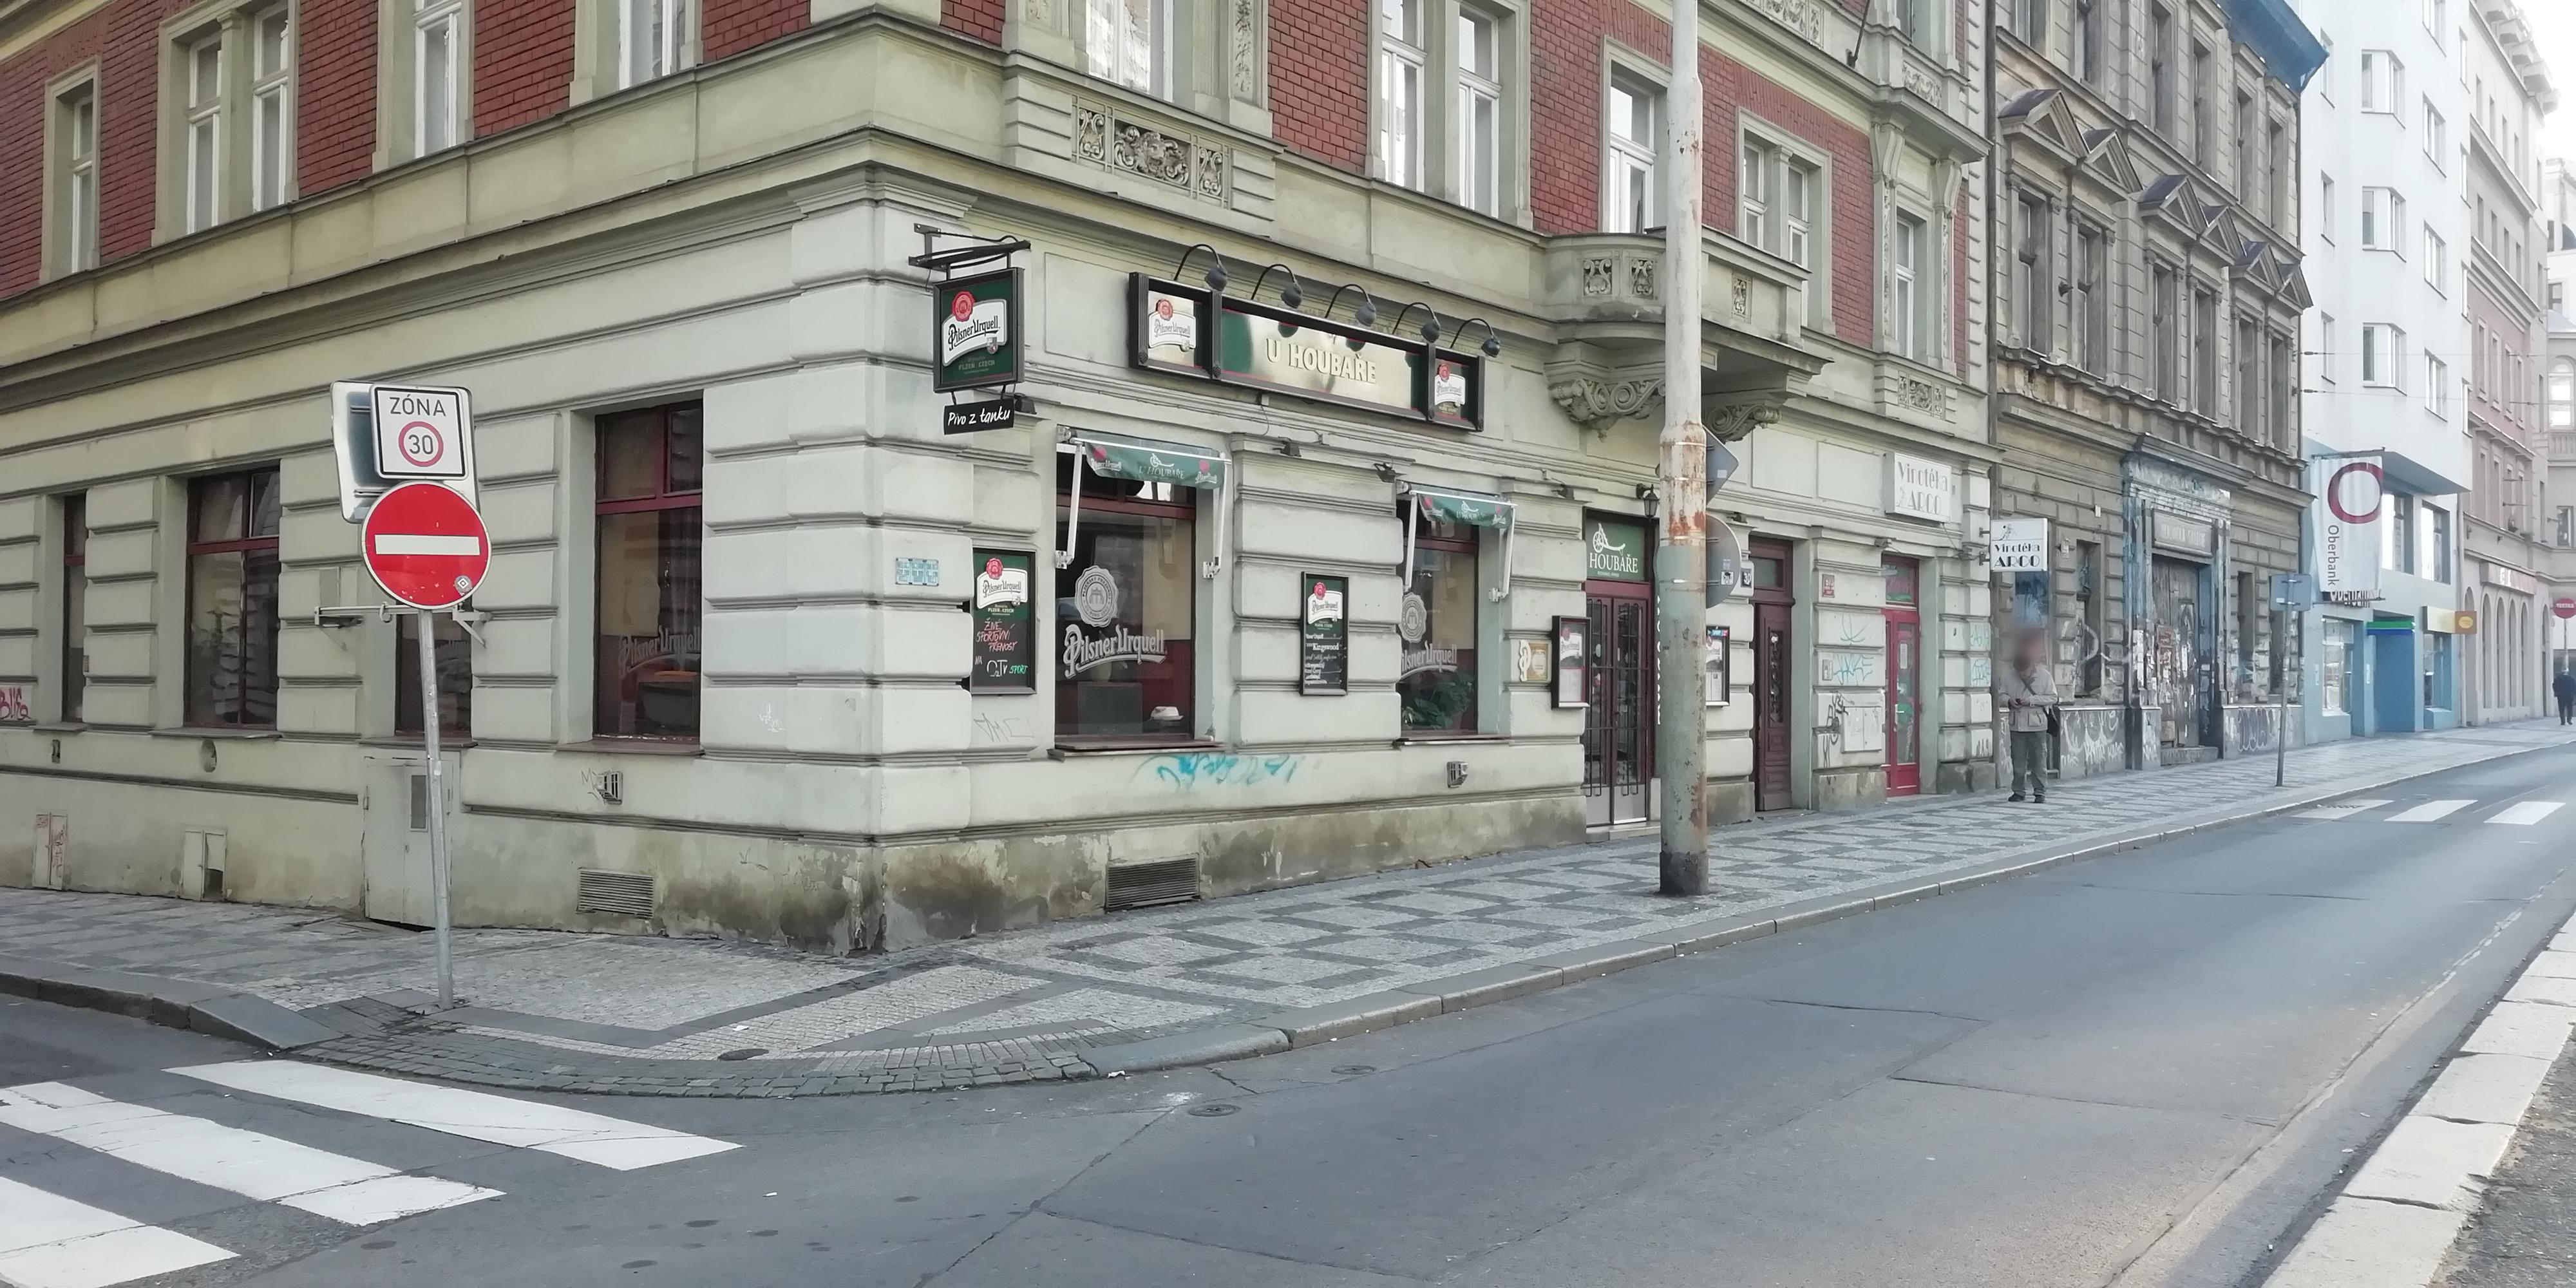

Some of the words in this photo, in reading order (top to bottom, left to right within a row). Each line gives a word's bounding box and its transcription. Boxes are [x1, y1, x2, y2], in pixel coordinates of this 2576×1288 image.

[948, 324, 974, 351] Pilsner
[972, 315, 999, 336] Urquell
[1153, 319, 1173, 337] Pilsner
[1172, 322, 1191, 337] Urquell
[1266, 338, 1281, 363] U
[1289, 343, 1376, 383] HOUBAŘE
[390, 394, 446, 417] ZÓNA
[948, 412, 966, 426] Pivo
[969, 413, 977, 424] z
[980, 406, 1011, 424] tanku
[408, 434, 434, 455] 30
[1898, 461, 1948, 492] Vinotéka
[1908, 490, 1941, 516] ARCO
[1994, 543, 2040, 553] Vinotéka
[2327, 524, 2340, 586] Oberbank
[1589, 553, 1639, 574] HOUBAŘE
[1994, 555, 2041, 567] ARCO
[982, 580, 1003, 598] Pilsner
[1002, 580, 1021, 594] Urquell
[1743, 572, 1752, 585] 30
[976, 623, 1016, 643] SPORTOVNÍ
[619, 634, 660, 679] Pilsner
[659, 625, 700, 670] Urquell
[988, 641, 1018, 652] PŘENOSY
[1063, 624, 1118, 679] Pilsner
[1115, 624, 1166, 665] Urquell
[1402, 649, 1426, 673] ilsner
[1425, 640, 1457, 674] Urquell
[974, 656, 983, 665] NA
[1009, 665, 1028, 674] SPORT
